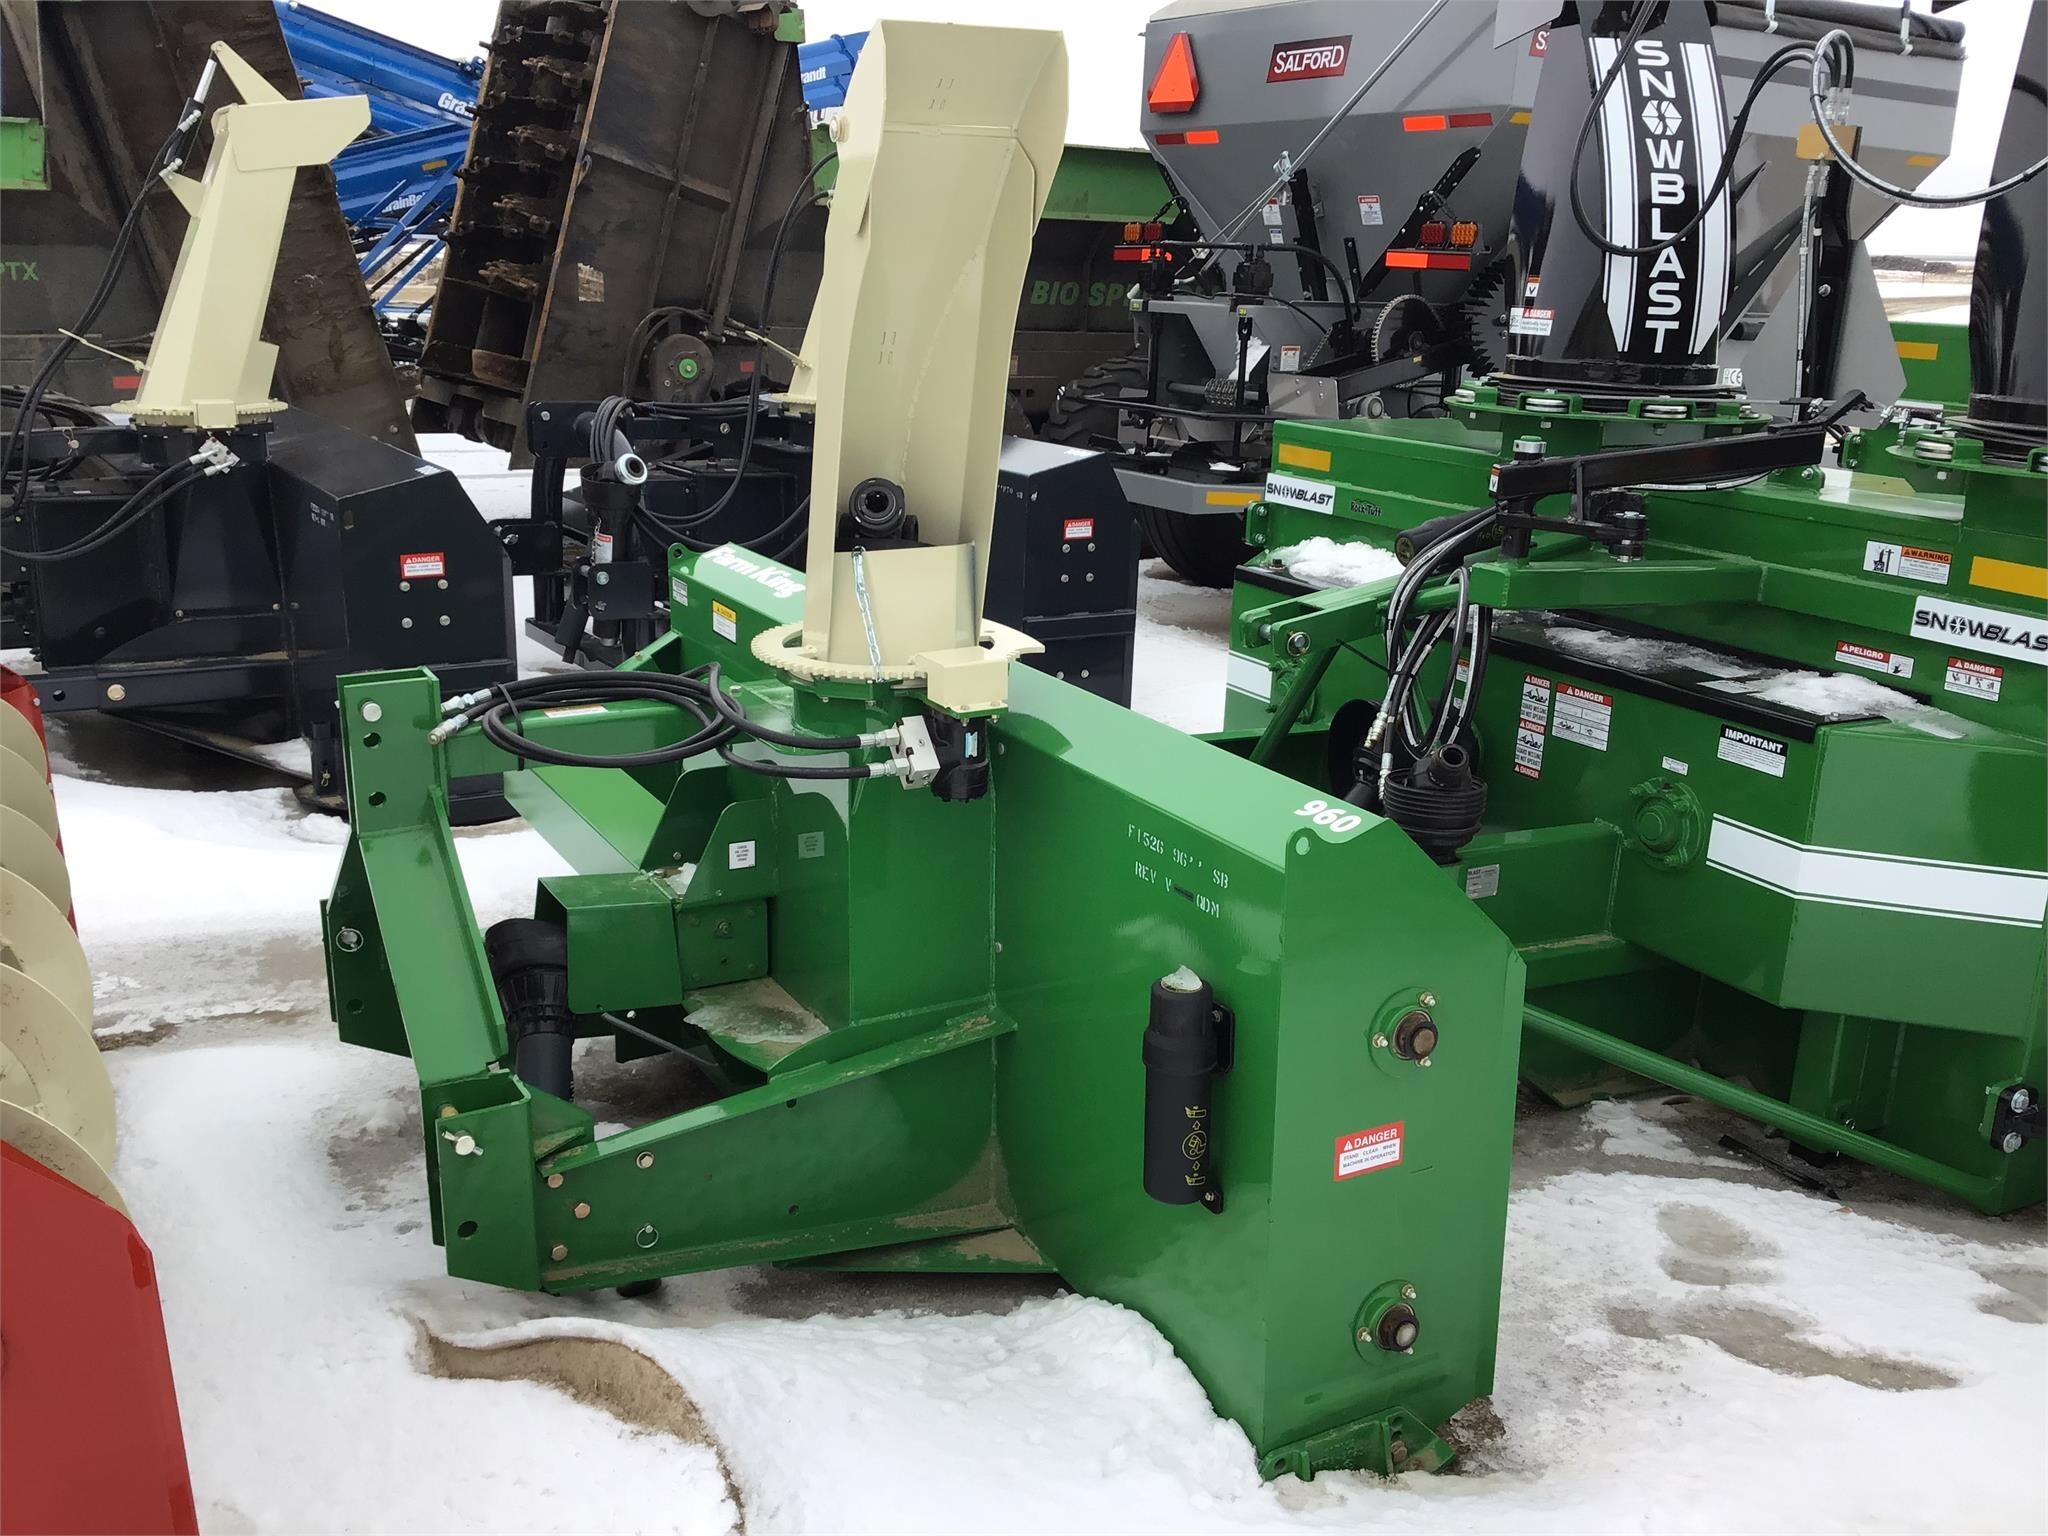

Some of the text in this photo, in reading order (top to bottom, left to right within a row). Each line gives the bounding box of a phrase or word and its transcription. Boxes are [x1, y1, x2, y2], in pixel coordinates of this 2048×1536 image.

[1273, 45, 1345, 74] SALFORD
[1030, 280, 1080, 305] BIO
[1266, 483, 1333, 506] SNOWBLAST
[412, 555, 440, 563] DANGER
[1911, 550, 1949, 562] WARNING
[1849, 645, 1884, 661] PELIGRO
[1963, 662, 1996, 676] DANGER
[1531, 676, 1551, 688] DANGER
[1574, 688, 1604, 703] DANGER
[1525, 722, 1545, 734] DANGER
[1724, 728, 1784, 753] IMPORTANT
[1520, 766, 1539, 778] DANGER
[1293, 800, 1362, 832] 960
[1135, 861, 1157, 884] REV
[1213, 869, 1229, 888] SB
[1354, 1128, 1397, 1148] DANGER
[1343, 1142, 1397, 1161] STAND CLEAR WHEN
[1343, 1159, 1363, 1168] MACHINE
[1369, 1150, 1396, 1161] OPERATION
